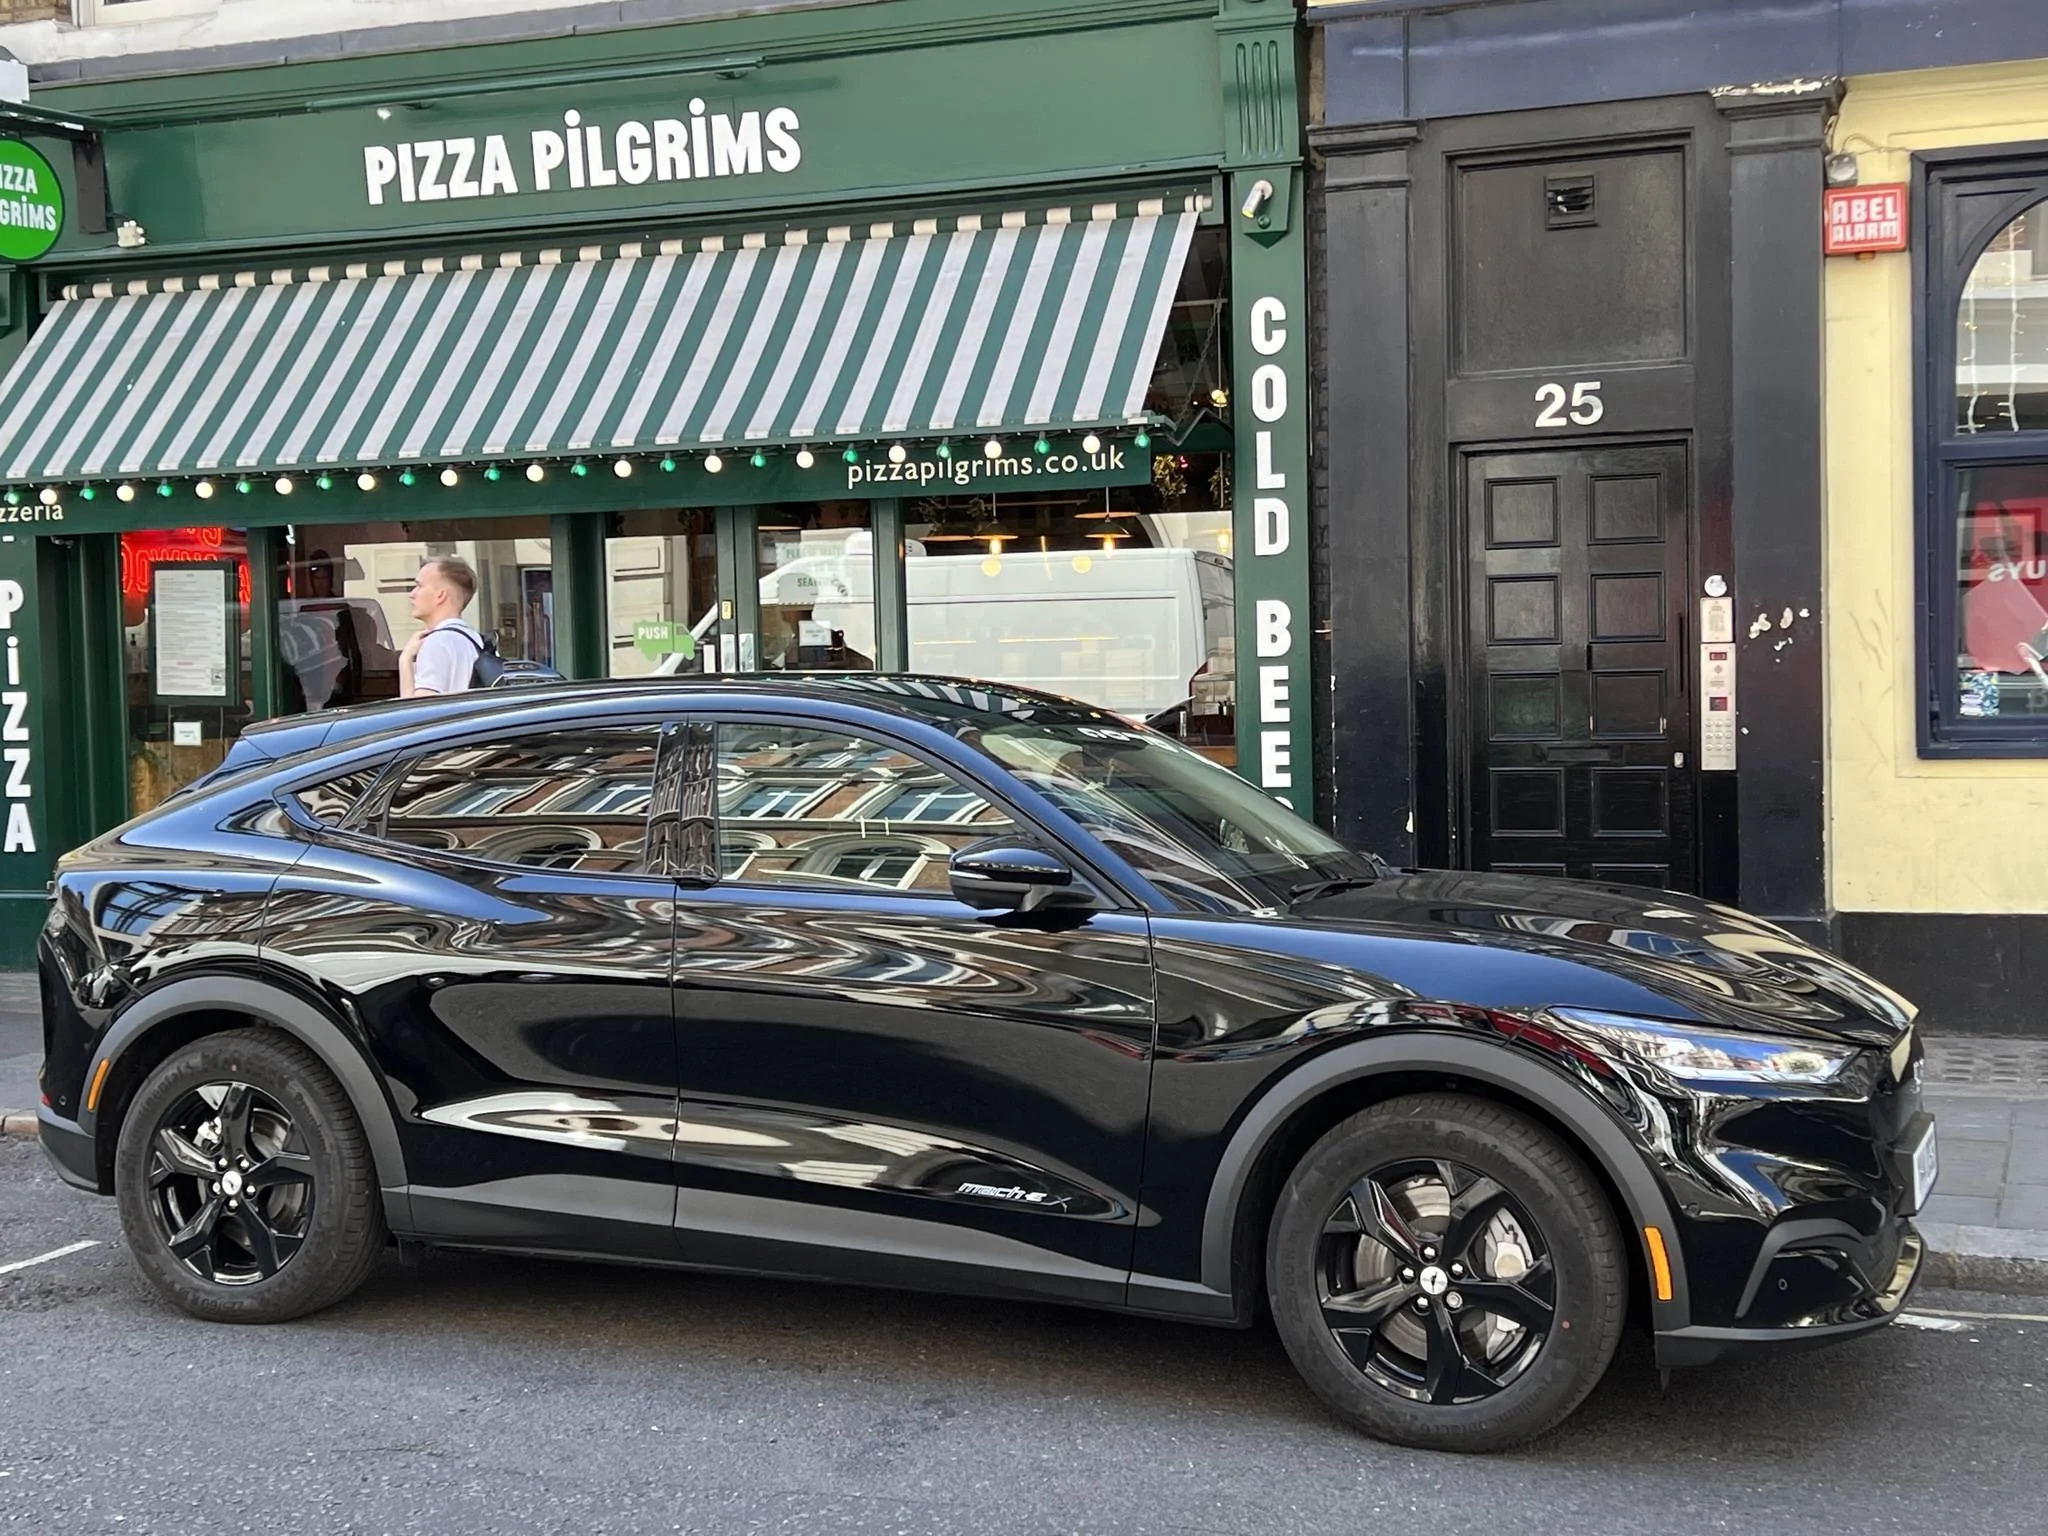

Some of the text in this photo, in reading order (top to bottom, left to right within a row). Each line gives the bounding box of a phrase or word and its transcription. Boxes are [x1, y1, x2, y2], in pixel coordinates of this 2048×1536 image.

[364, 134, 519, 205] PIZZA
[1832, 196, 1898, 224] ABEL
[1833, 221, 1898, 243] ALARM
[1534, 381, 1604, 428] 25
[847, 444, 1126, 489] pizzapilgrims.co.uk
[1250, 296, 1294, 810] COLD BEE
[638, 626, 668, 640] PUSH
